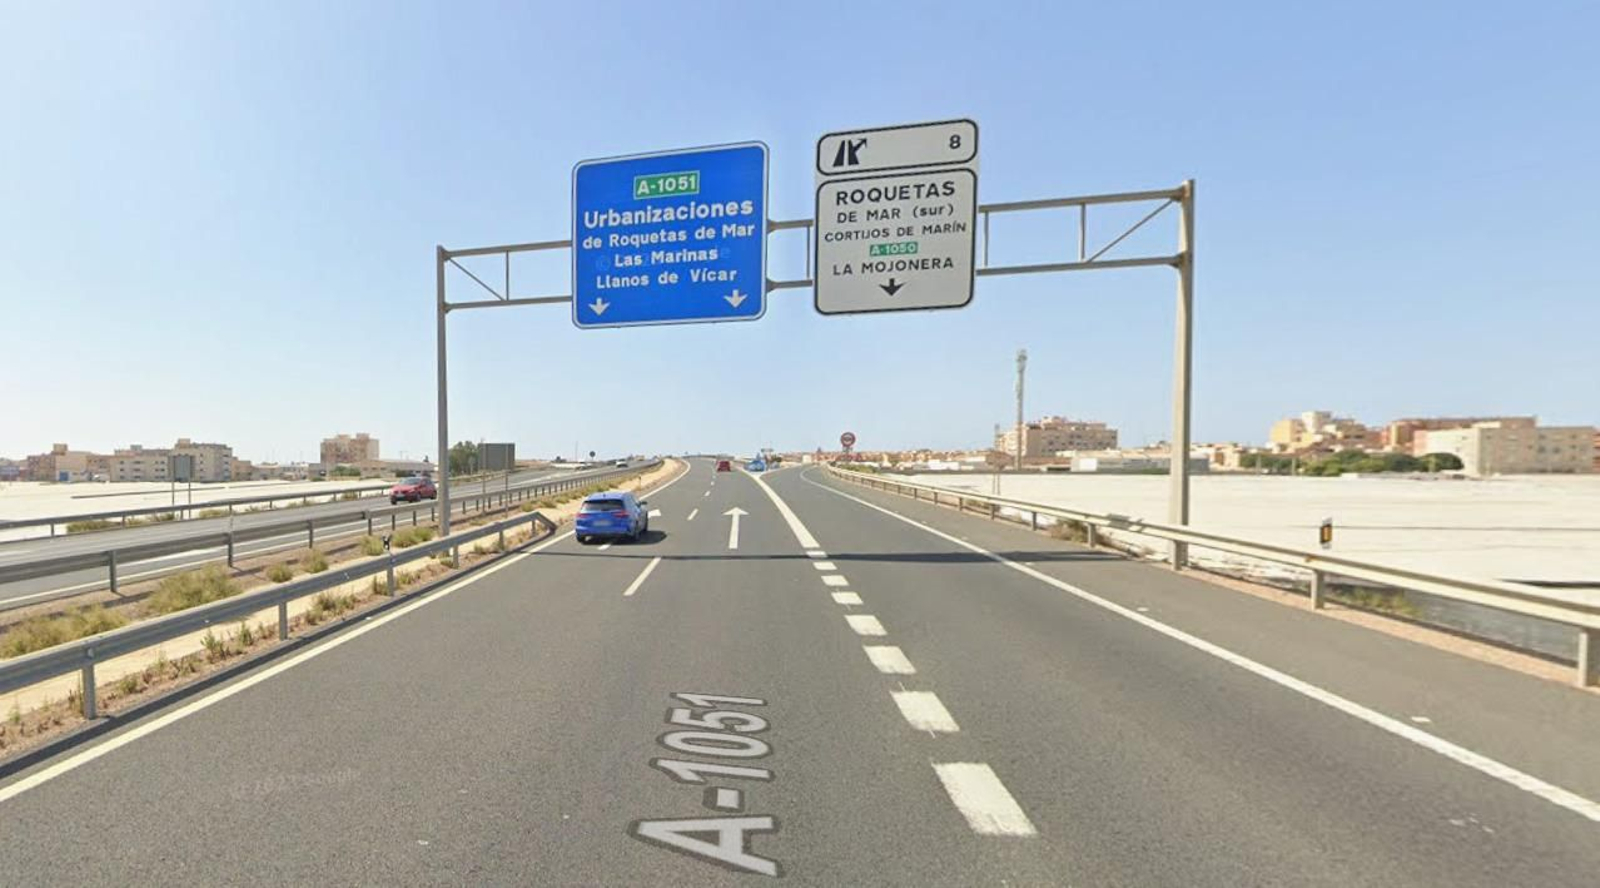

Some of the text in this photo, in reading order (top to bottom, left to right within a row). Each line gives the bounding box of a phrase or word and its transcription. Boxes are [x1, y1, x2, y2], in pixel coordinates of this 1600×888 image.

[949, 134, 961, 149] 8
[636, 175, 696, 195] A-1051
[836, 181, 955, 206] ROQUETAS
[584, 200, 753, 229] Urbanizaciones
[837, 204, 954, 224] DE MAR (sur)
[582, 224, 755, 249] de Roquetas de Mar
[825, 221, 966, 242] CORTIJOS DE MARÍN
[615, 254, 642, 267] Las
[651, 248, 718, 265] Marinas
[833, 257, 954, 276] LA MOJONERA
[597, 267, 737, 289] Llanos de Vícar
[638, 693, 778, 877] A-1051
